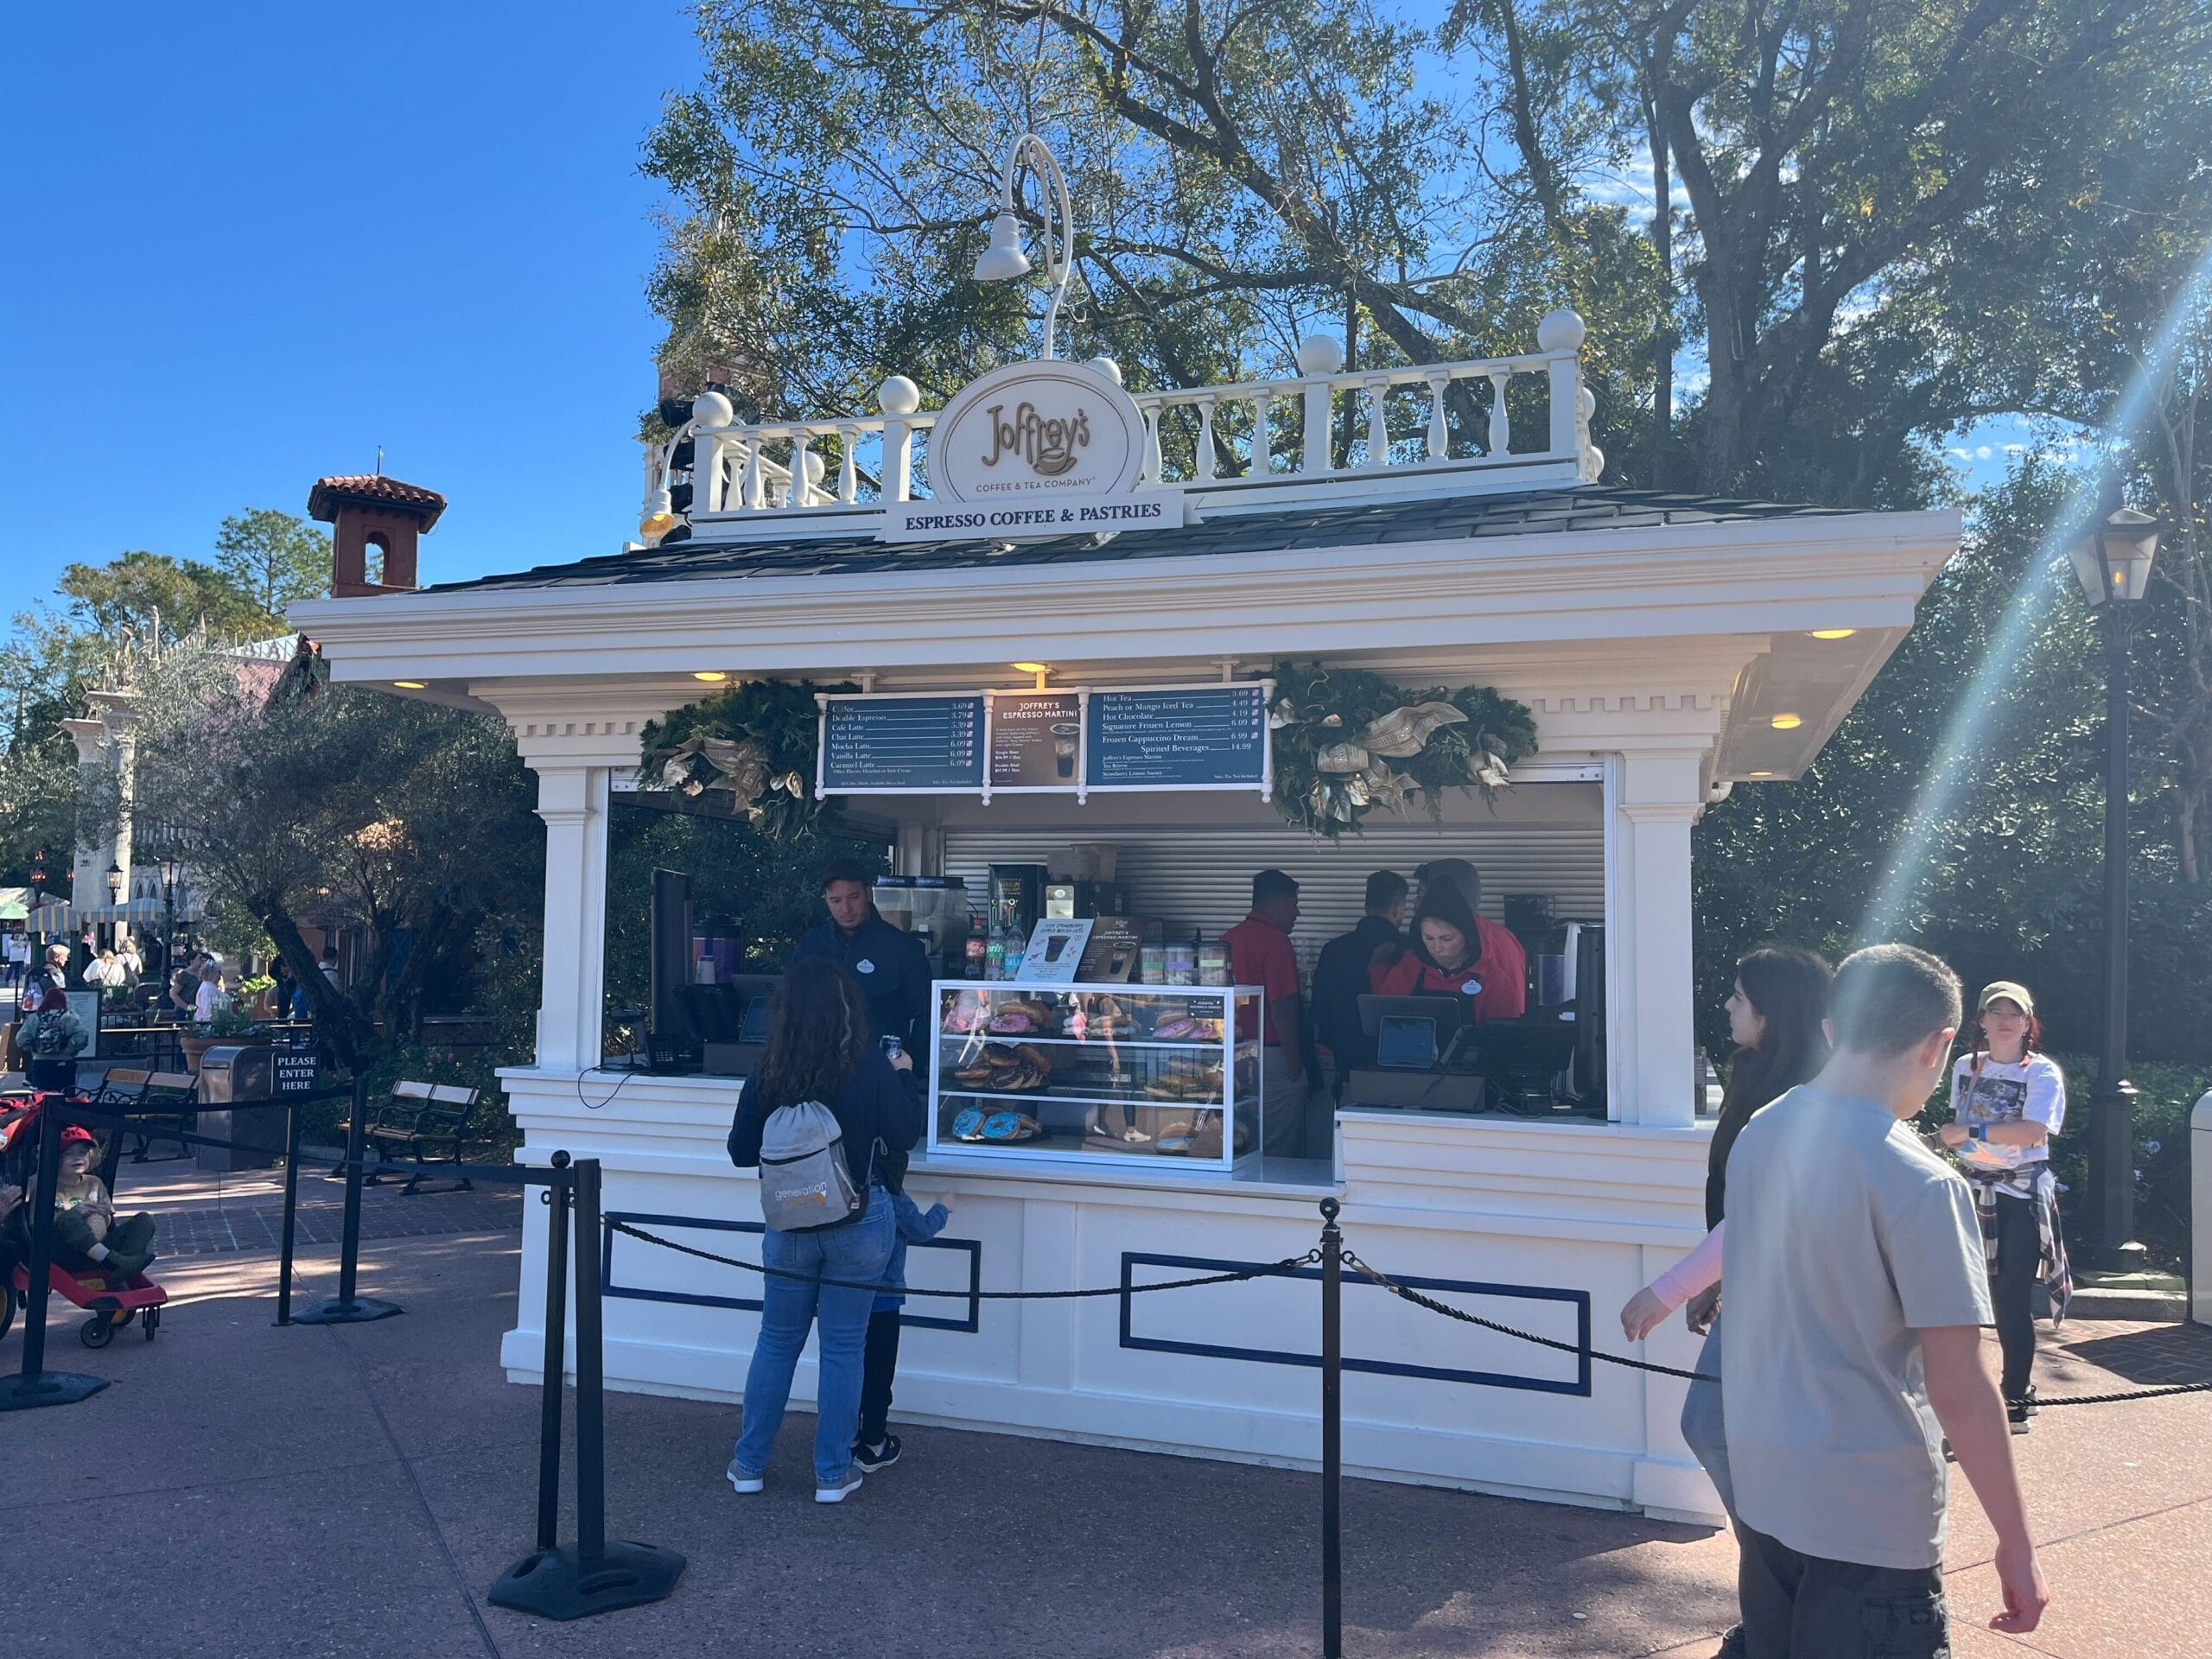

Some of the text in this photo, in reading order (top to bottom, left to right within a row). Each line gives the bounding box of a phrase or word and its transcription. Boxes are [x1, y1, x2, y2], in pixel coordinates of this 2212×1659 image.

[982, 402, 1091, 467] Joffrey's
[976, 482, 1012, 493] COFFEE
[1024, 481, 1042, 490] TEA
[1044, 478, 1092, 488] COMPANY
[906, 503, 1161, 531] ESPRESSO COFFEE & PASTRIES
[1019, 702, 1060, 712] JOFFREY'S
[1103, 703, 1123, 712] Peach
[1135, 703, 1160, 712] Mango
[858, 714, 887, 722] Espresso
[1044, 709, 1077, 718] MARTINI
[1102, 723, 1136, 732] Signature
[1128, 734, 1172, 744] Cappuccino
[1141, 744, 1170, 753] Spirited
[1172, 744, 1210, 753] Beverages
[277, 1057, 317, 1066] PLEASE
[279, 1068, 315, 1078] ENTER
[282, 1081, 311, 1090] HERE
[774, 1181, 827, 1202] generation
